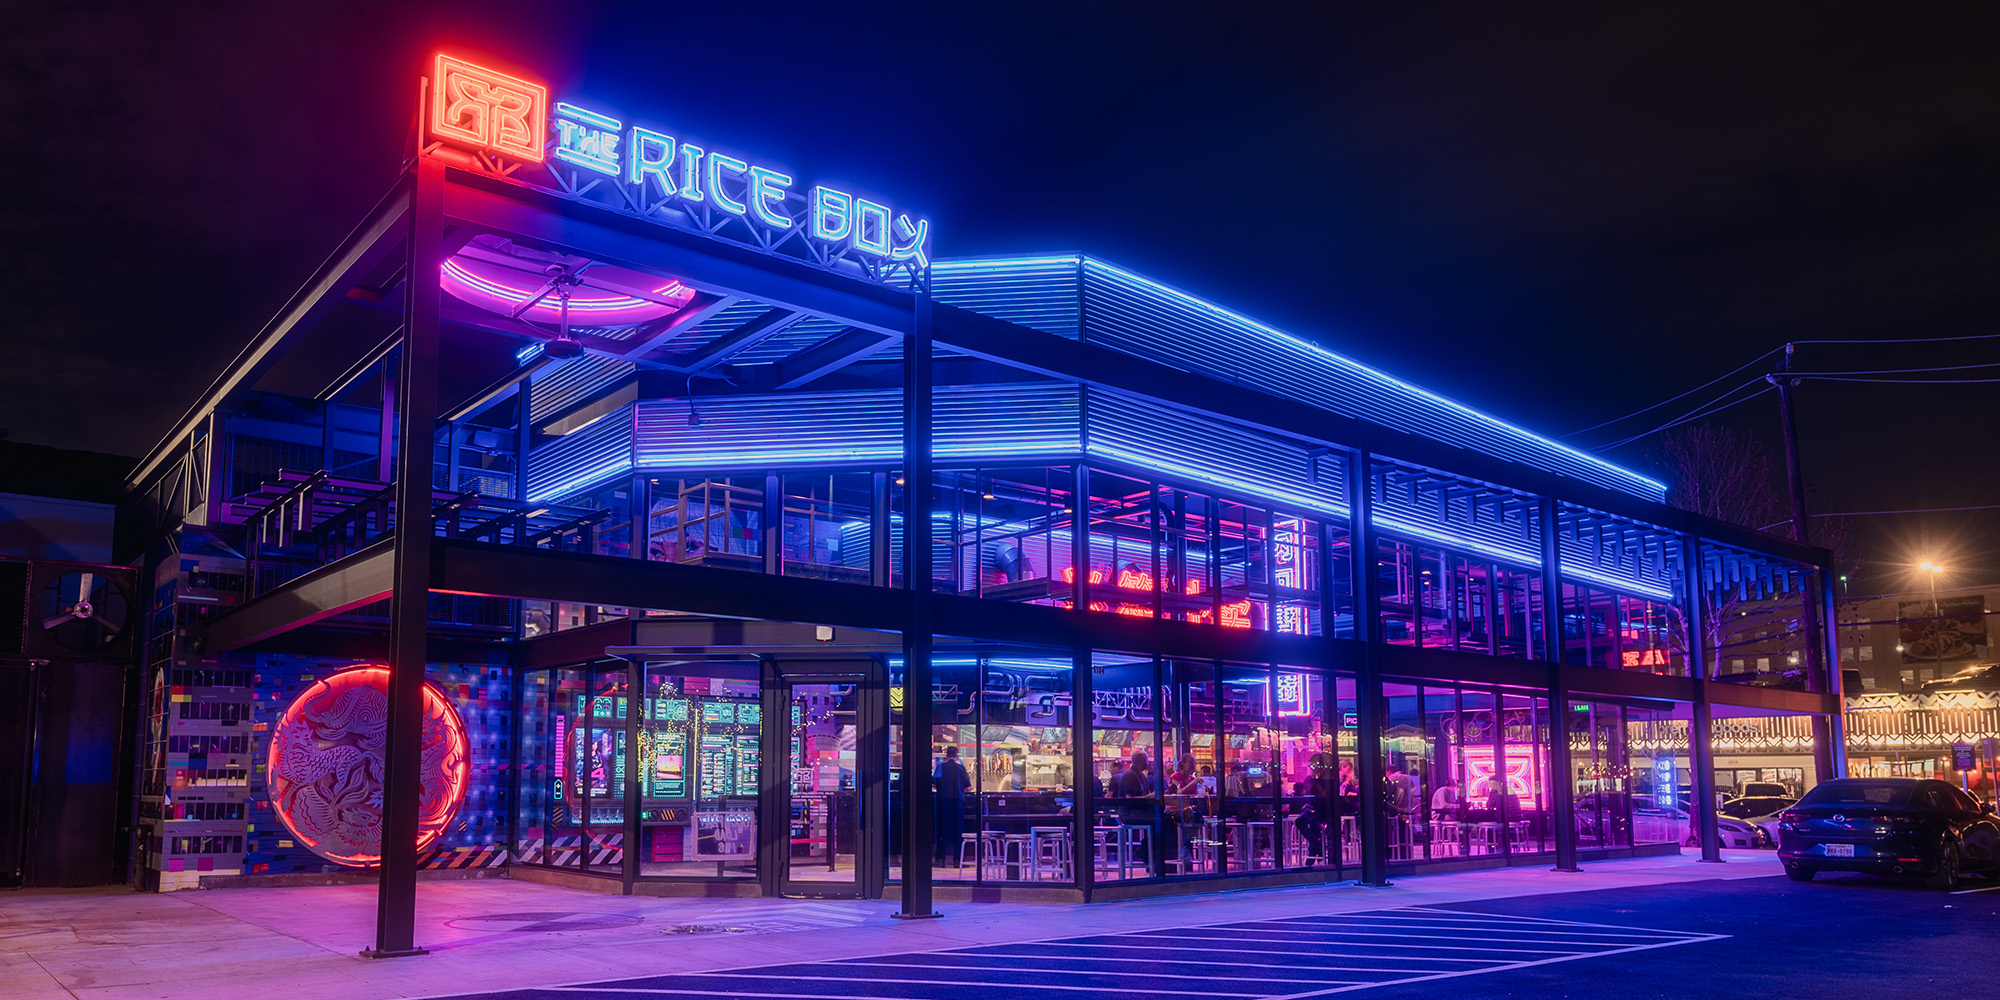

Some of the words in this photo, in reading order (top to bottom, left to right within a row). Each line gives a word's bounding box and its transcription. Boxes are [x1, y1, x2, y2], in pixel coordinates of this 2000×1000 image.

[554, 118, 620, 164] THE
[627, 125, 792, 229] RICE
[808, 184, 928, 269] BOX
